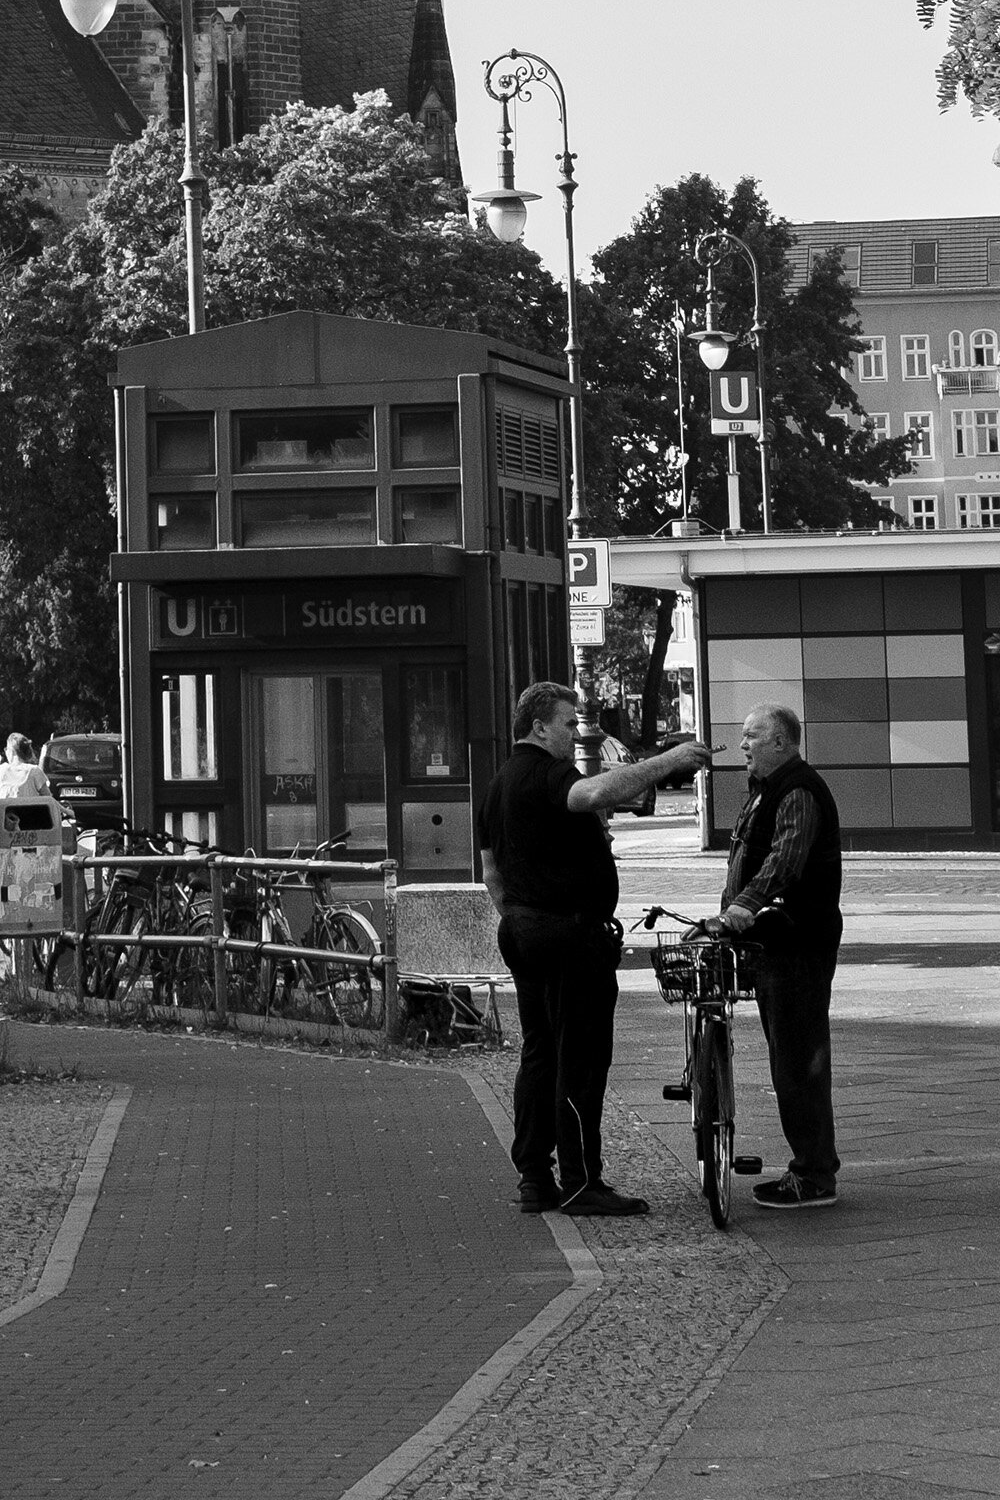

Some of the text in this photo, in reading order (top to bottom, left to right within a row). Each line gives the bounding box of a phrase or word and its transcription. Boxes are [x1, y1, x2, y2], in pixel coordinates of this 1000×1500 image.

[720, 377, 748, 413] U
[731, 422, 742, 430] U7
[569, 553, 588, 582] P
[167, 599, 196, 636] U
[301, 599, 426, 628] Südstern
